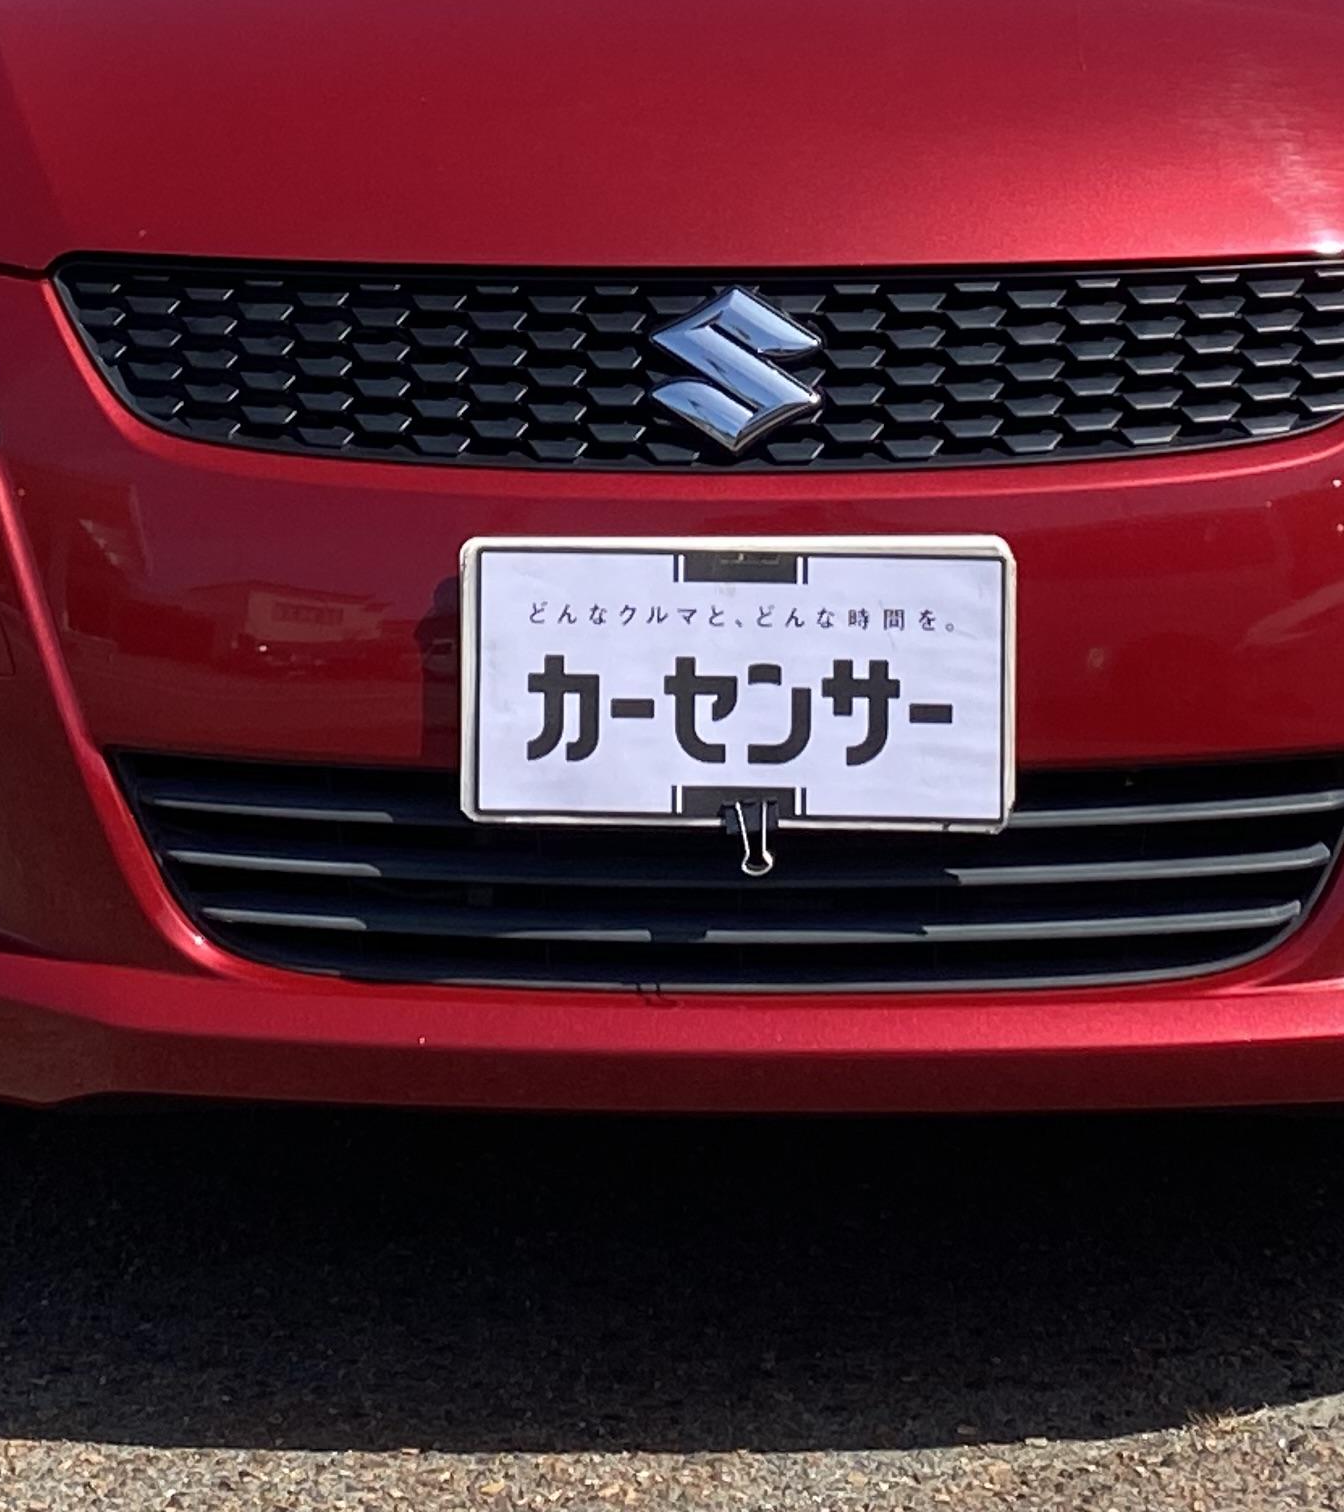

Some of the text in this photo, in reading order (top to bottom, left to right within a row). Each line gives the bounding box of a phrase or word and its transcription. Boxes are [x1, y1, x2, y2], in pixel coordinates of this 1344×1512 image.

[528, 600, 956, 633] どんなクルマと、どんな時間を。
[526, 654, 954, 767] カーセンサー
